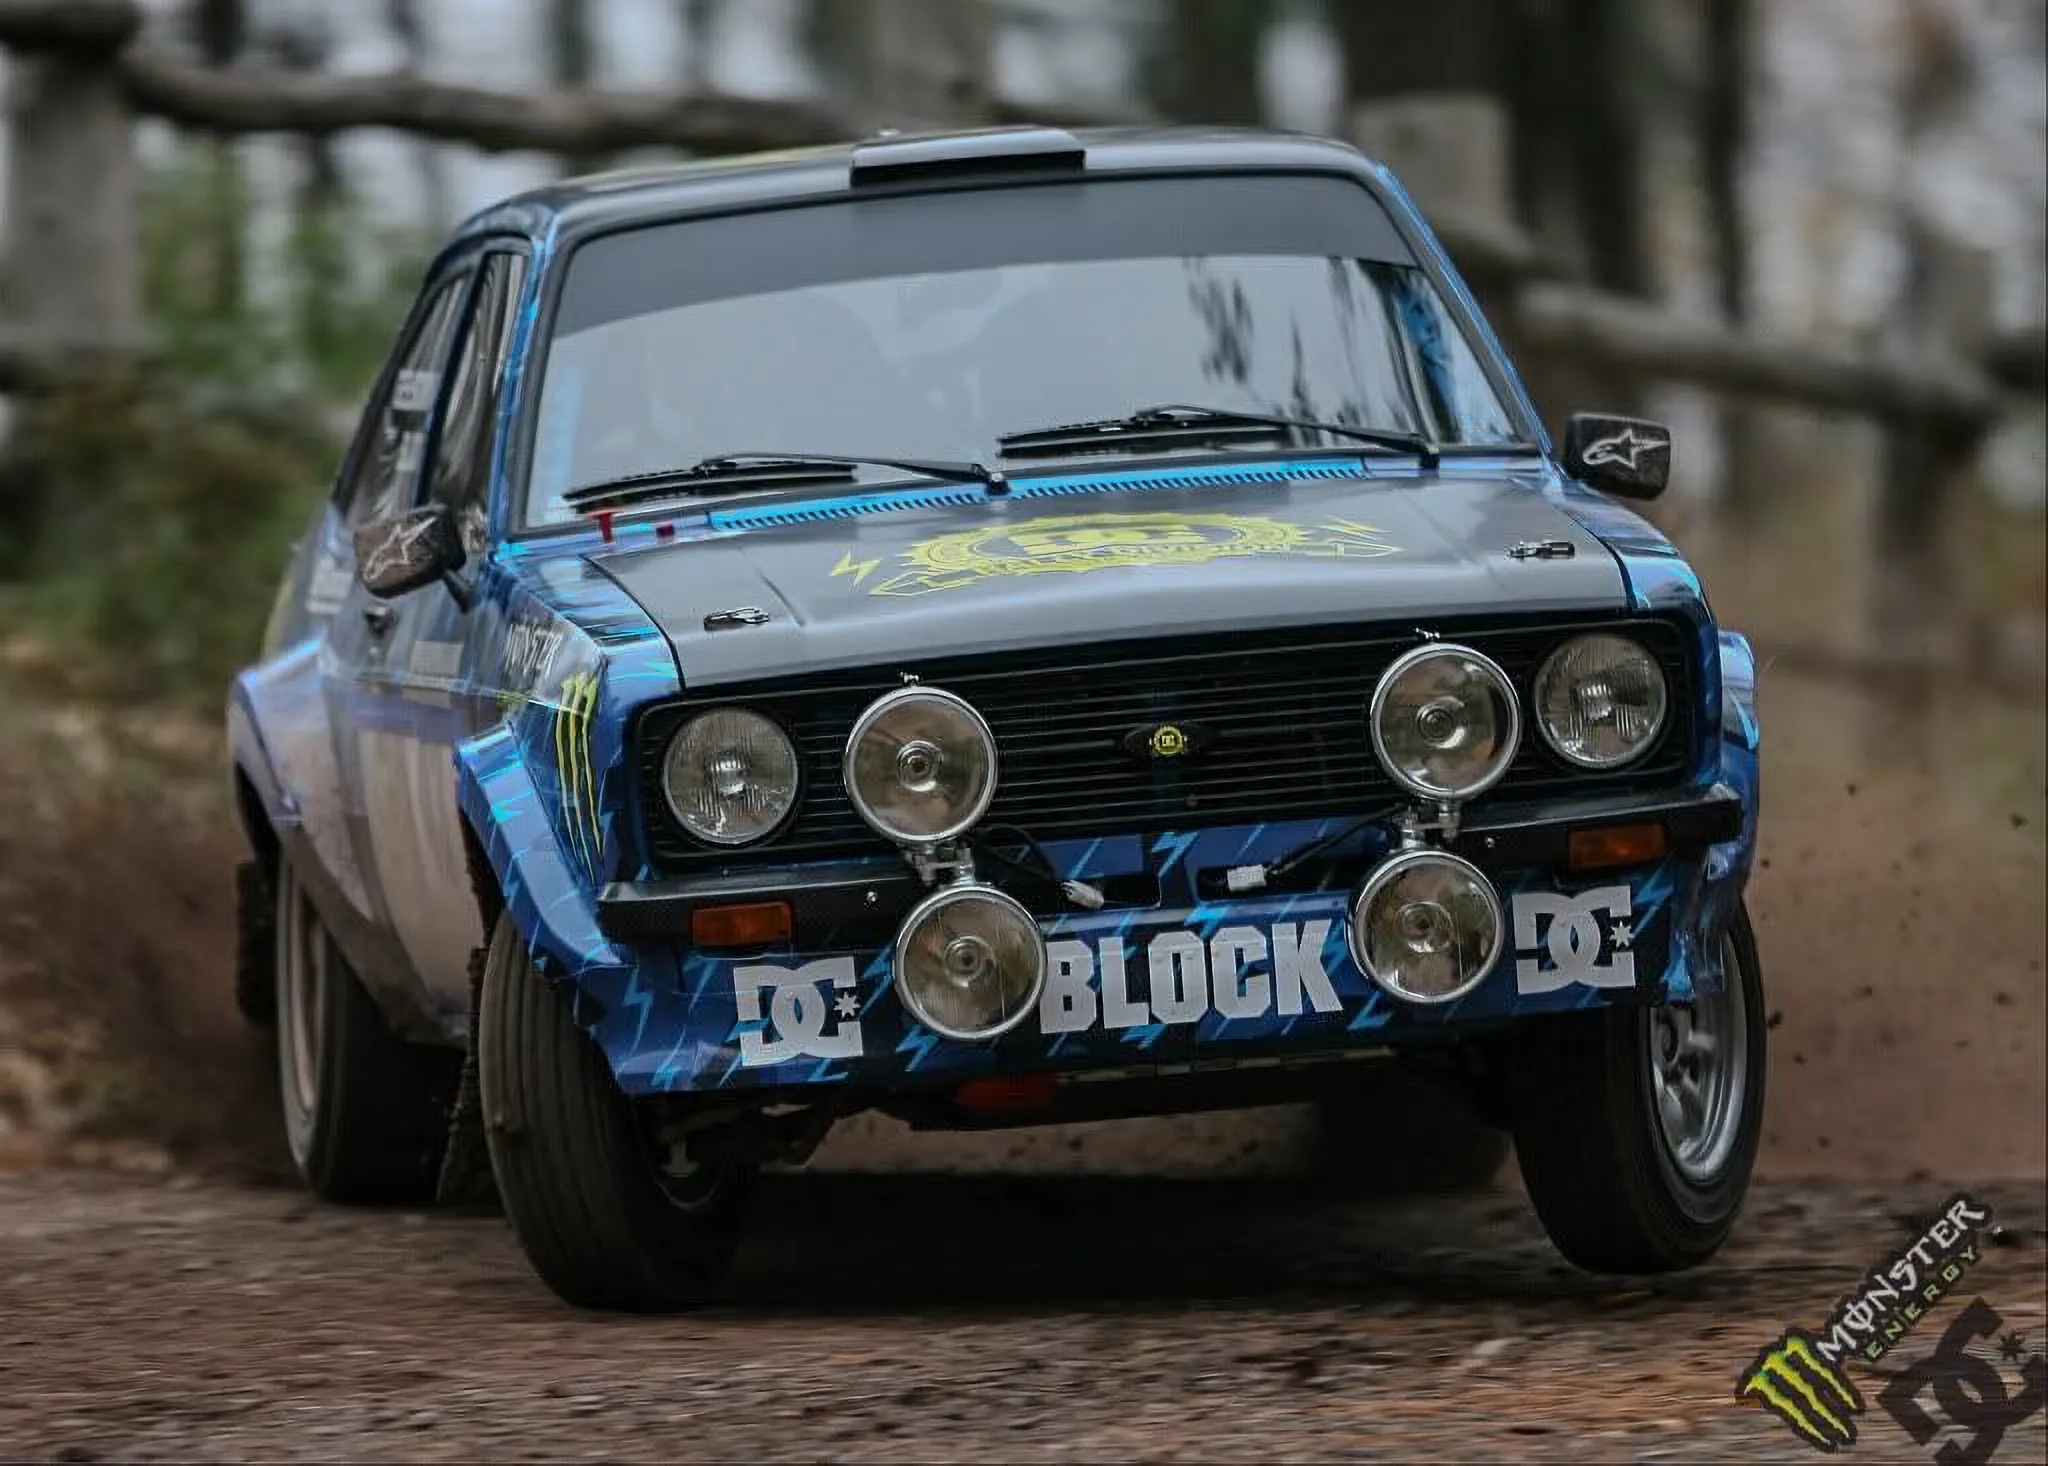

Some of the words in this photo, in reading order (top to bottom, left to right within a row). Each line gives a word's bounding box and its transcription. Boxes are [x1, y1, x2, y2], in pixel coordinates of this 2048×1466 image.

[1040, 919, 1343, 1034] BLOCK
[1512, 886, 1636, 995] DC
[734, 957, 863, 1067] DC
